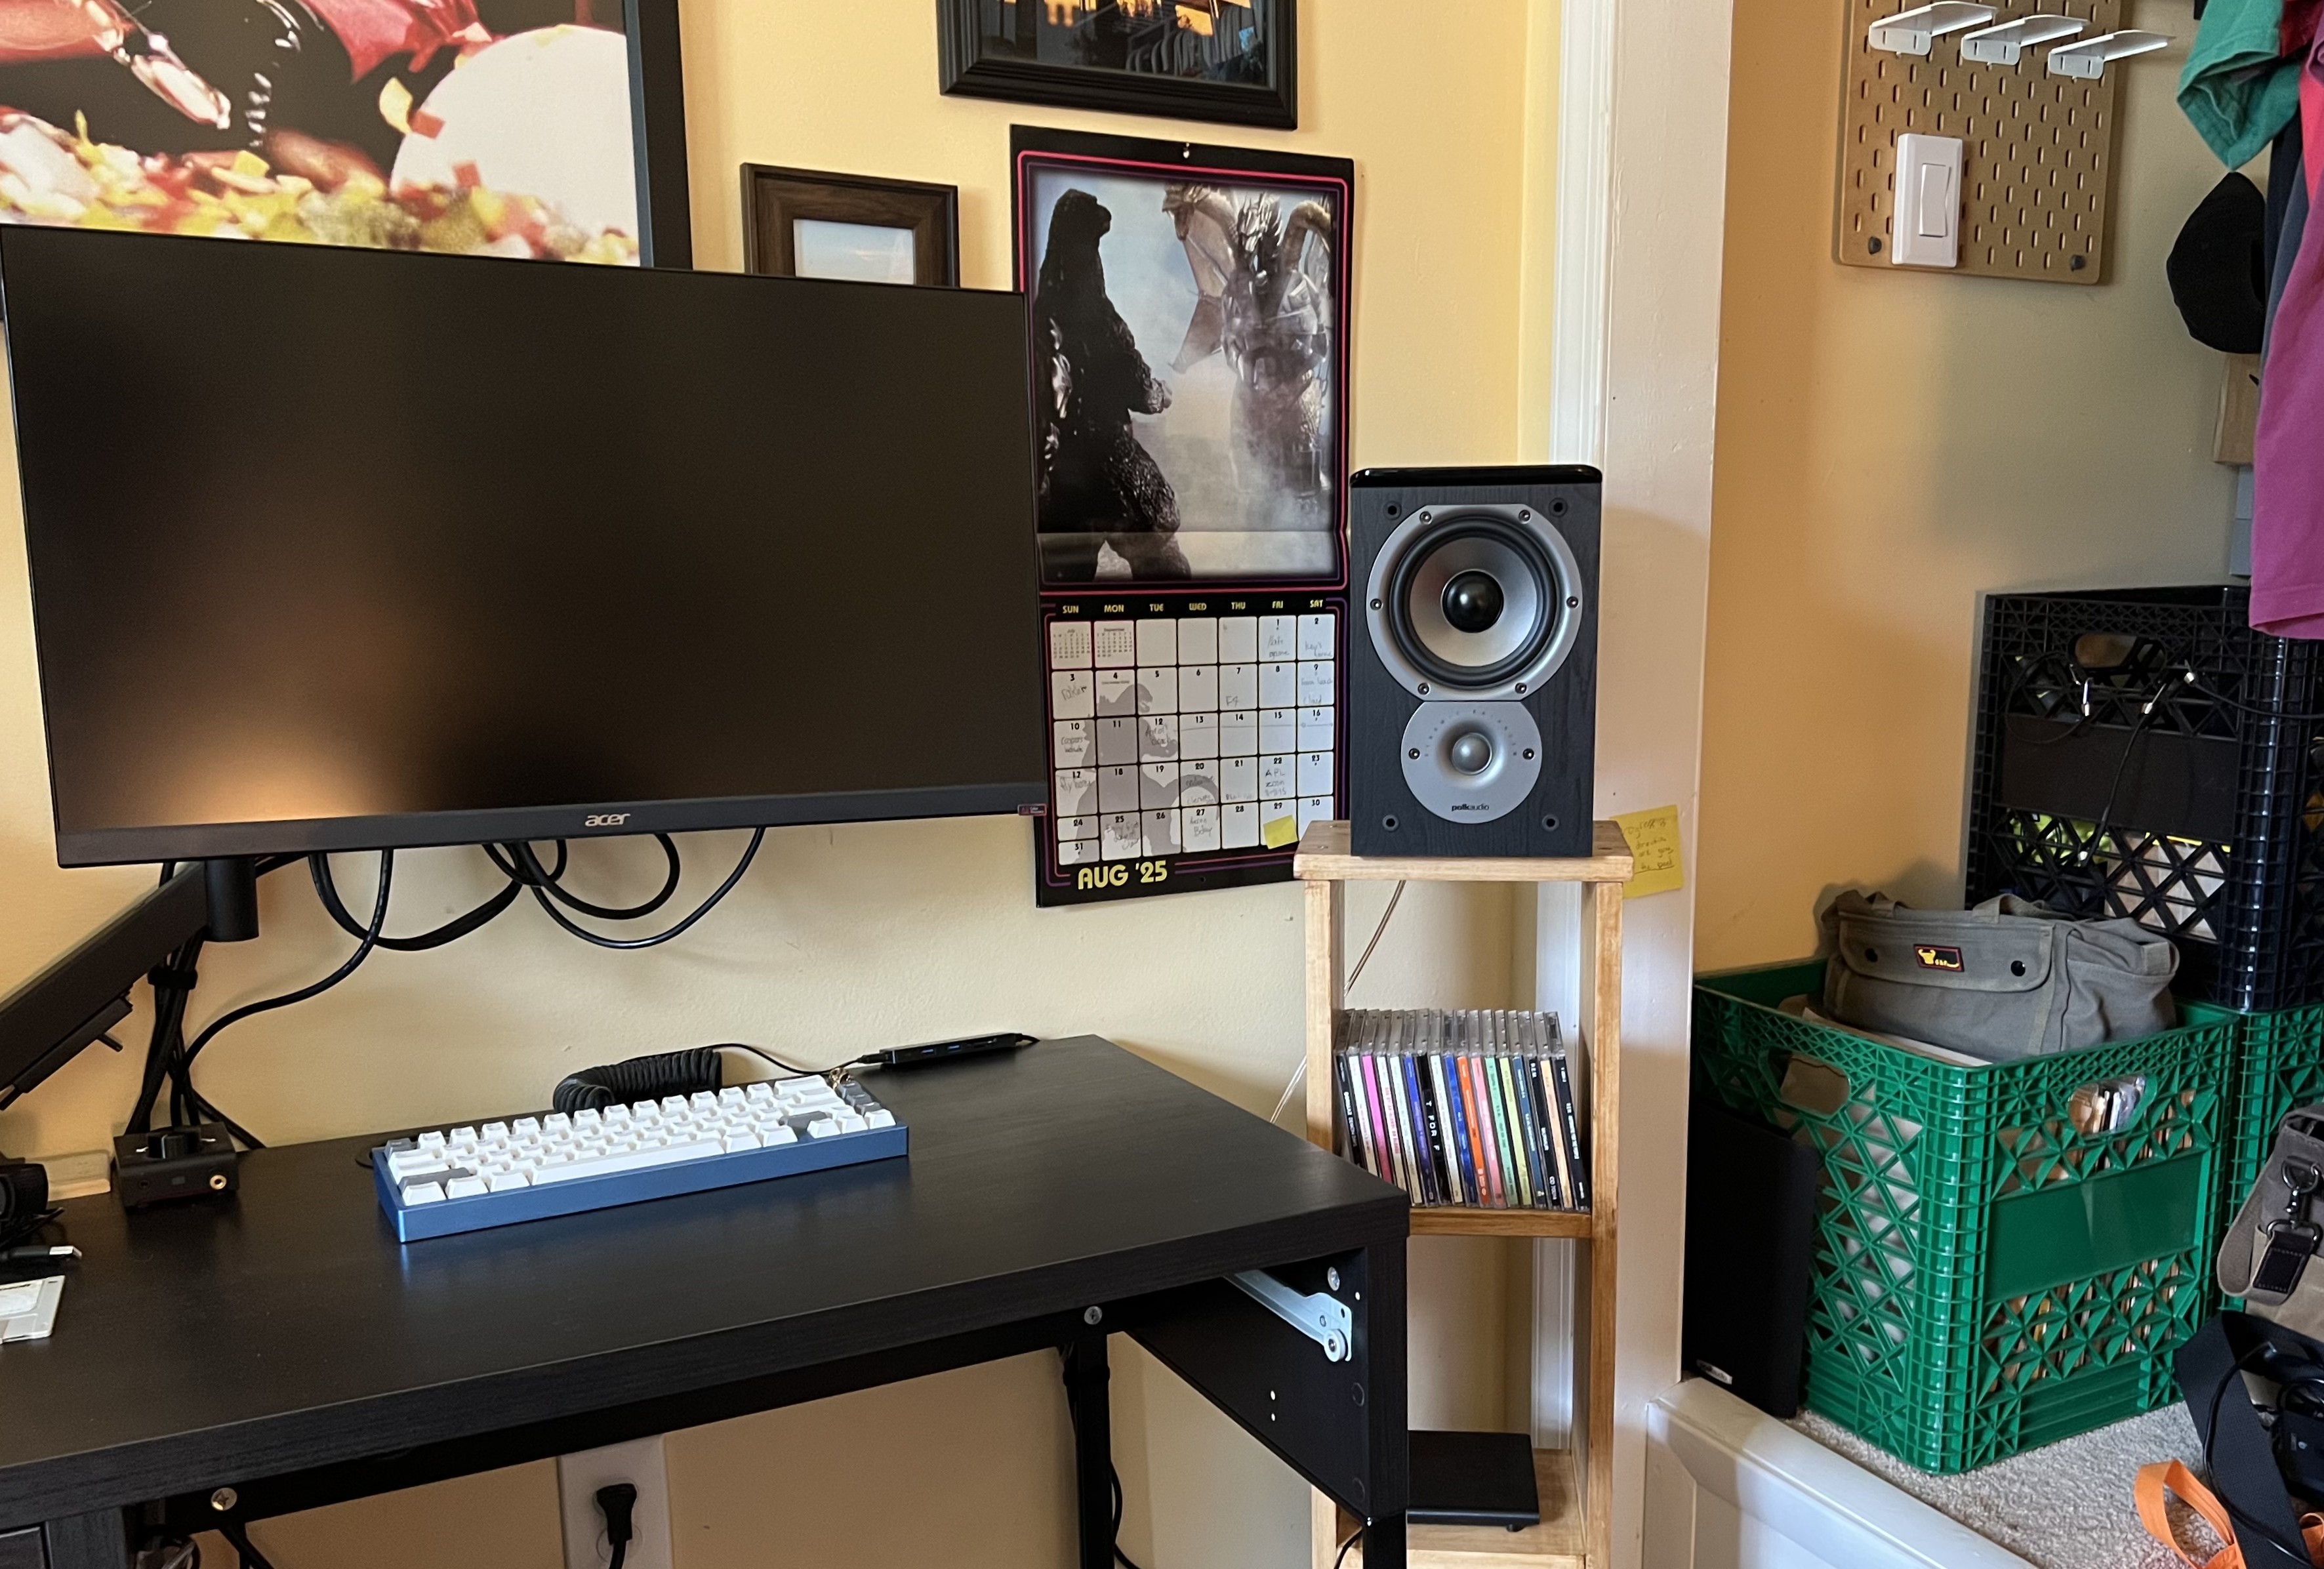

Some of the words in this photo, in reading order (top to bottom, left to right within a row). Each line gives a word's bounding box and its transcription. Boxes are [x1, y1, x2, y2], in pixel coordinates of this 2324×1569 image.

[1062, 605, 1079, 613] SUN
[1103, 604, 1124, 613] MON
[1149, 603, 1164, 612] TUE
[1189, 602, 1207, 611] WED
[1231, 601, 1246, 610] THU
[1272, 600, 1283, 609] FRI
[1309, 600, 1324, 608] SAT
[1451, 803, 1490, 812] polkaudio
[584, 813, 631, 827] acer
[1078, 864, 1128, 890] AUG
[1135, 859, 1168, 884] '25
[1427, 1114, 1437, 1137] FOR
